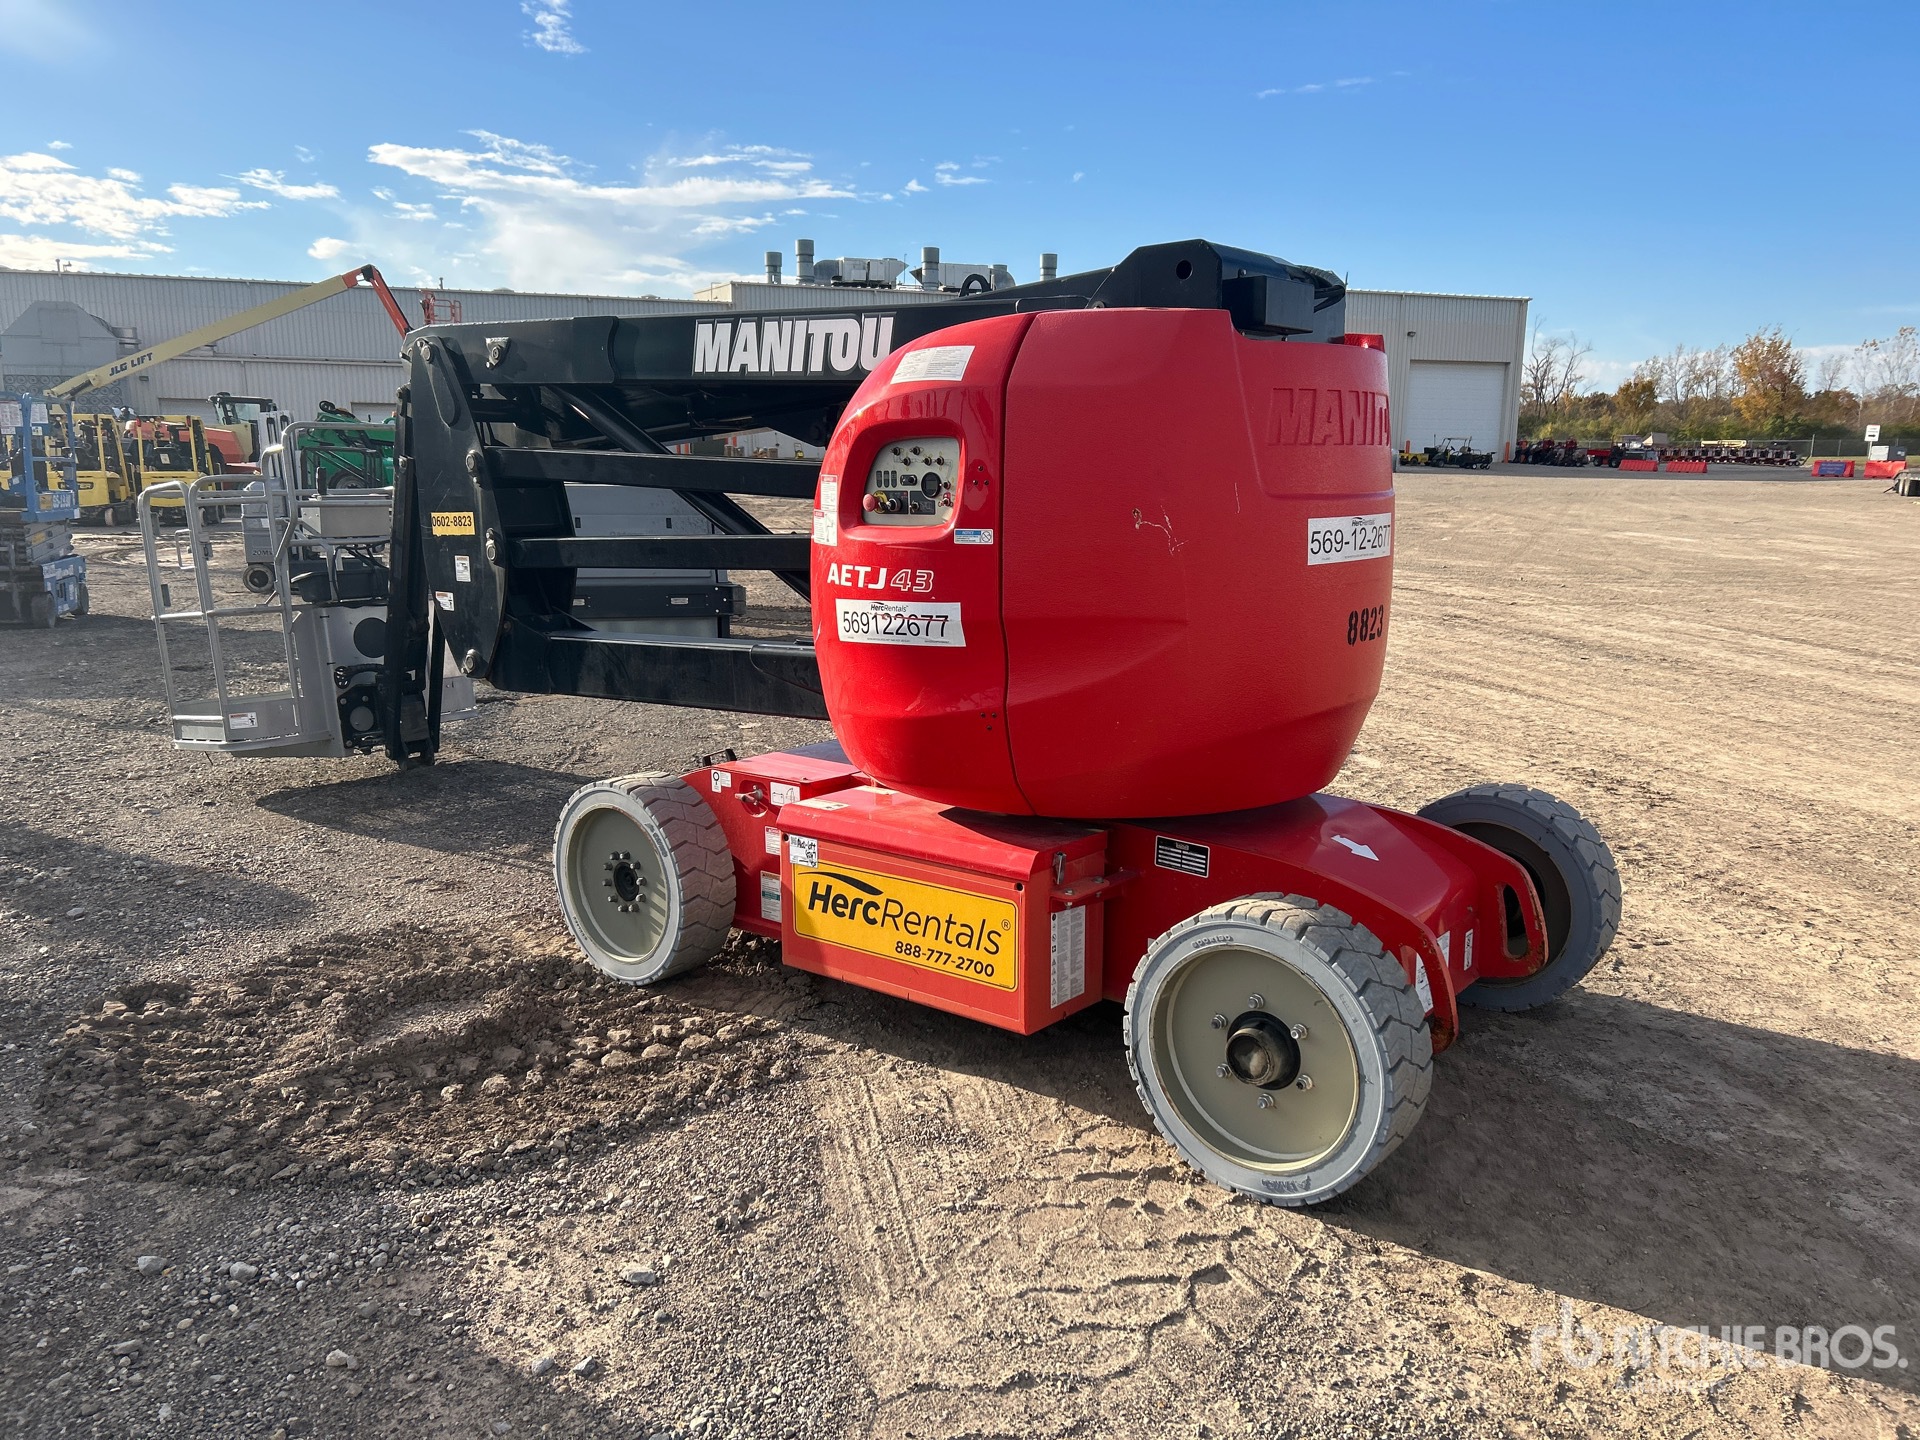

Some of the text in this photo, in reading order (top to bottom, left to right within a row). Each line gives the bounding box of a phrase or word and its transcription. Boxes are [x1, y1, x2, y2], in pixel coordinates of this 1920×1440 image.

[693, 313, 896, 375] MANITOU
[109, 352, 153, 377] JLG LIFT
[432, 515, 472, 527] 0602-8823
[827, 562, 934, 593] AETJ 43
[843, 611, 949, 638] 569122677
[1347, 604, 1384, 647] 8823
[895, 940, 995, 978] 888-777-2700
